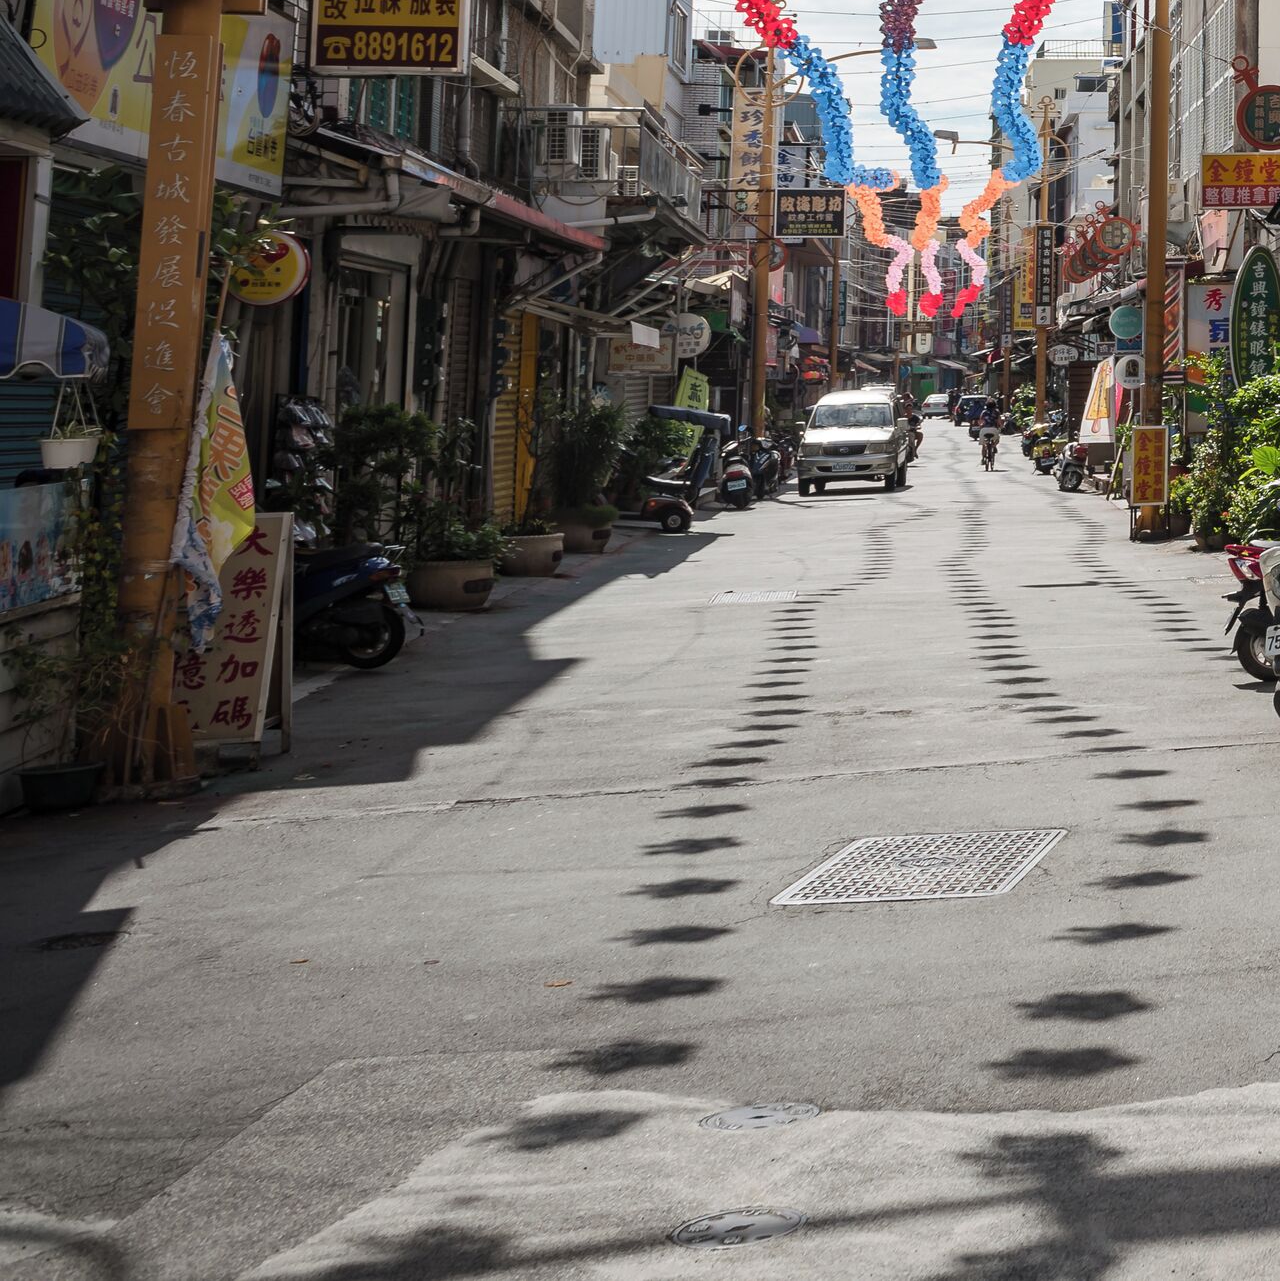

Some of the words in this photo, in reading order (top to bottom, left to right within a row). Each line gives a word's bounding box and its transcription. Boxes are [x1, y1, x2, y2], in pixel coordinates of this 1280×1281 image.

[353, 31, 453, 64] 8891612
[1135, 431, 1153, 501] 金鐘堂
